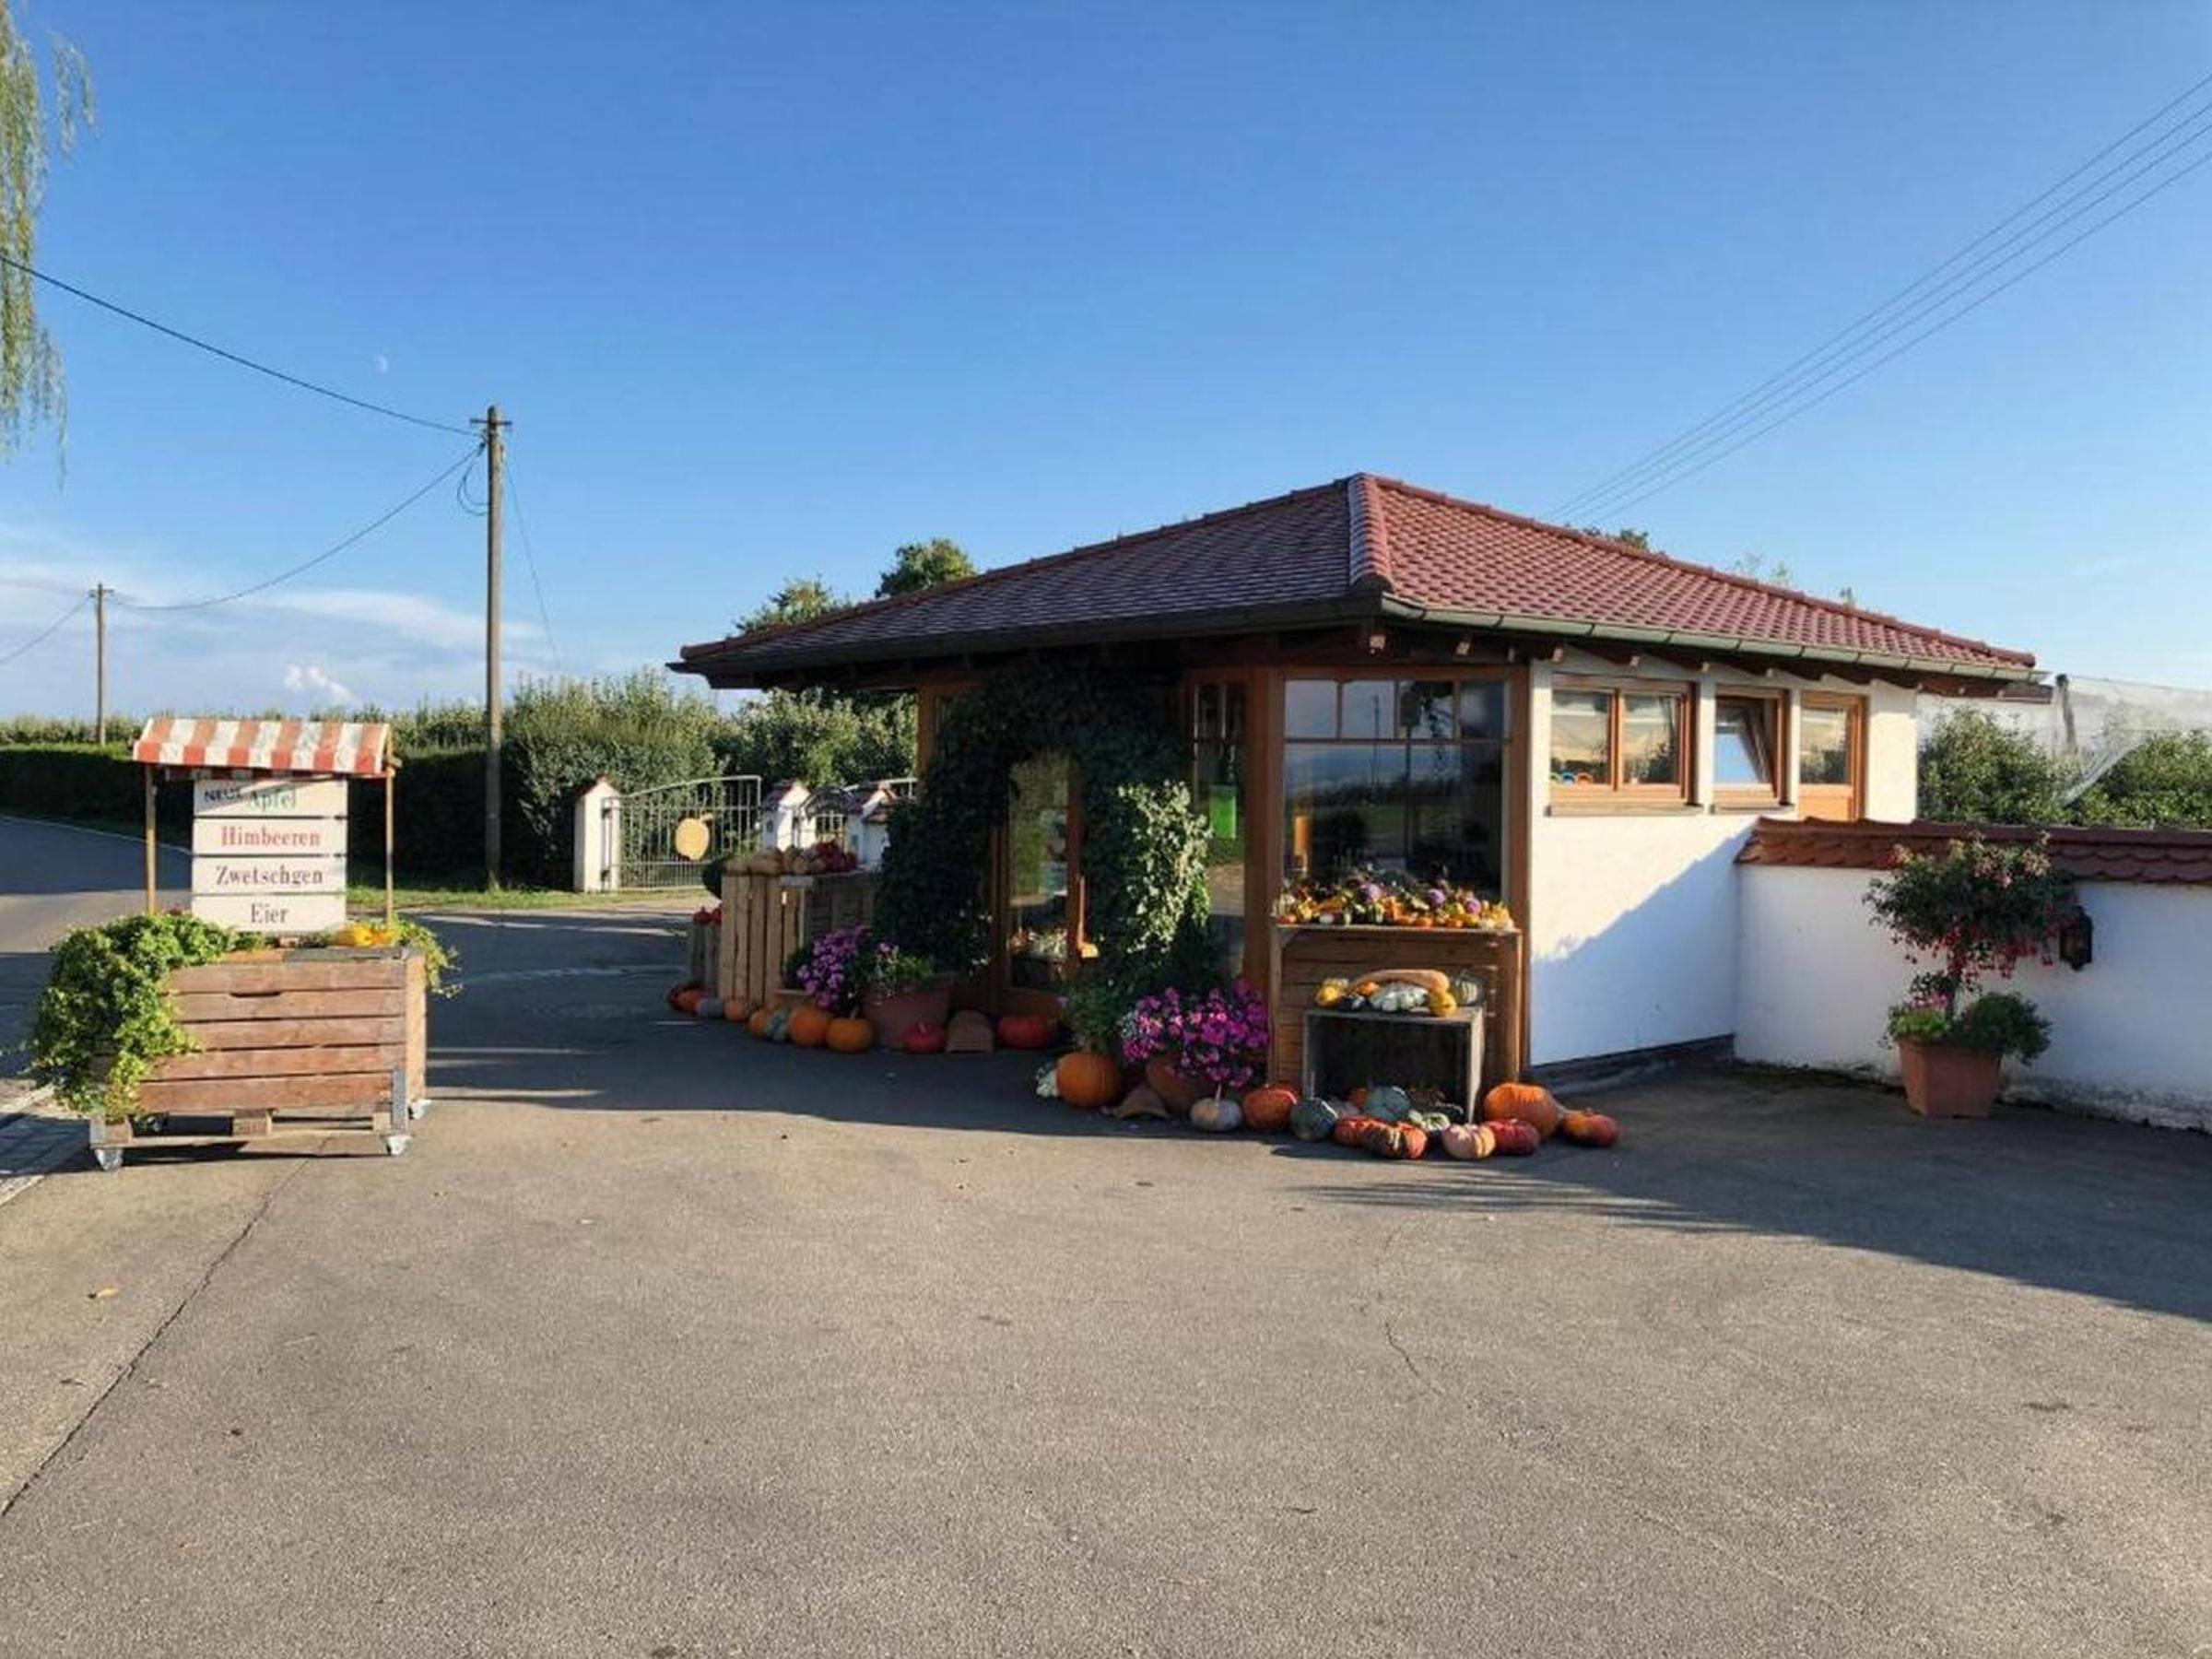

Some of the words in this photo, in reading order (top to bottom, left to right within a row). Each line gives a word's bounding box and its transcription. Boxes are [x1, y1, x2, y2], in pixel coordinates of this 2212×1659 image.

[220, 826, 321, 847] Himbeeren
[216, 865, 324, 886] Zwetschgen
[251, 903, 288, 924] Eier
